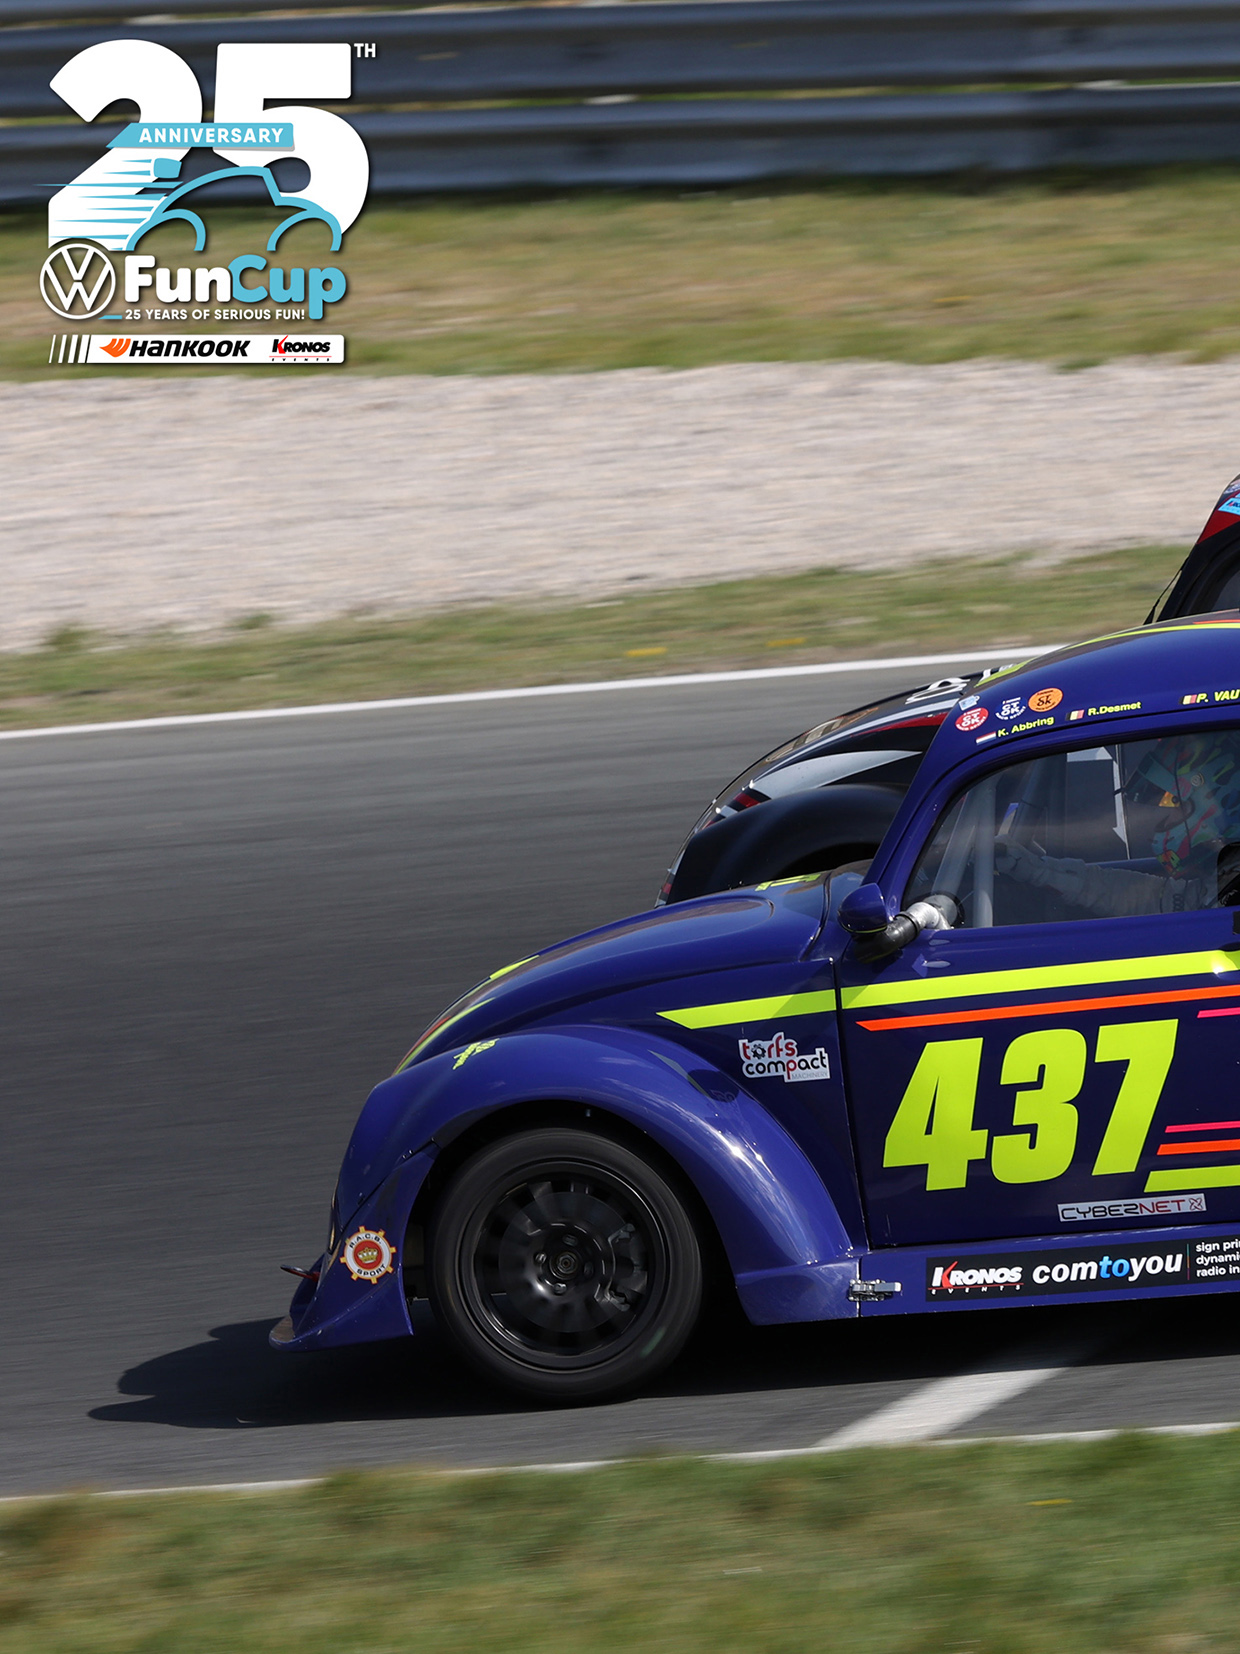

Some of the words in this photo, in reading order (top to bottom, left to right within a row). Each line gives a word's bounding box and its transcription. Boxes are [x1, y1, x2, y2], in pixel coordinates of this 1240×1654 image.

[1196, 692, 1210, 704] P.
[997, 728, 1009, 737] K.
[1011, 716, 1055, 734] Abbring
[745, 1050, 828, 1081] compact
[882, 1018, 1179, 1192] 437
[1195, 1241, 1220, 1253] sign
[356, 1263, 387, 1277] SPORT
[931, 1261, 1023, 1288] KRONOS
[1032, 1252, 1183, 1285] comtoyou
[1196, 1266, 1226, 1277] radio
